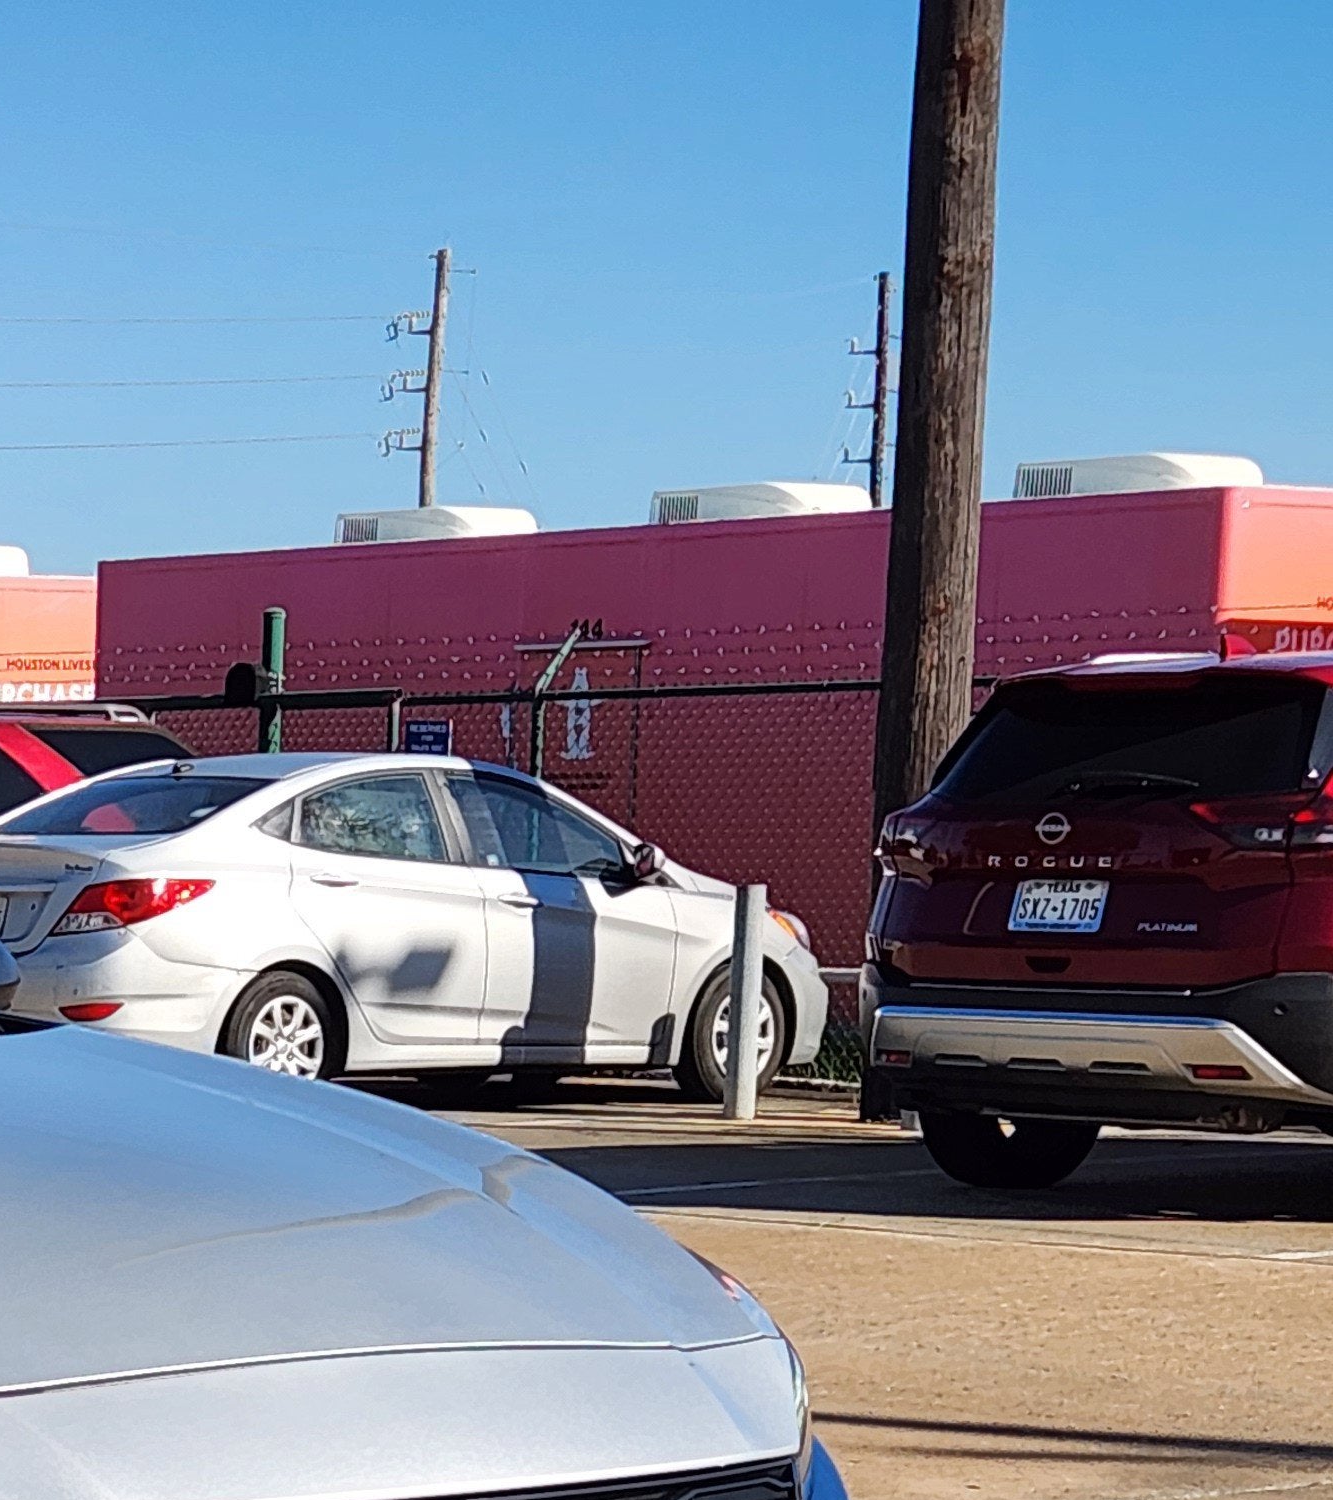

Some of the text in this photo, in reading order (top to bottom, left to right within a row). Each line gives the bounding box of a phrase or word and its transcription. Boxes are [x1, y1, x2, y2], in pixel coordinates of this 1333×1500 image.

[6, 658, 92, 671] HOUSTON LIVES
[988, 855, 1112, 868] ROGUE
[1047, 881, 1081, 893] TEXAS
[1137, 922, 1199, 932] PLATINUM
